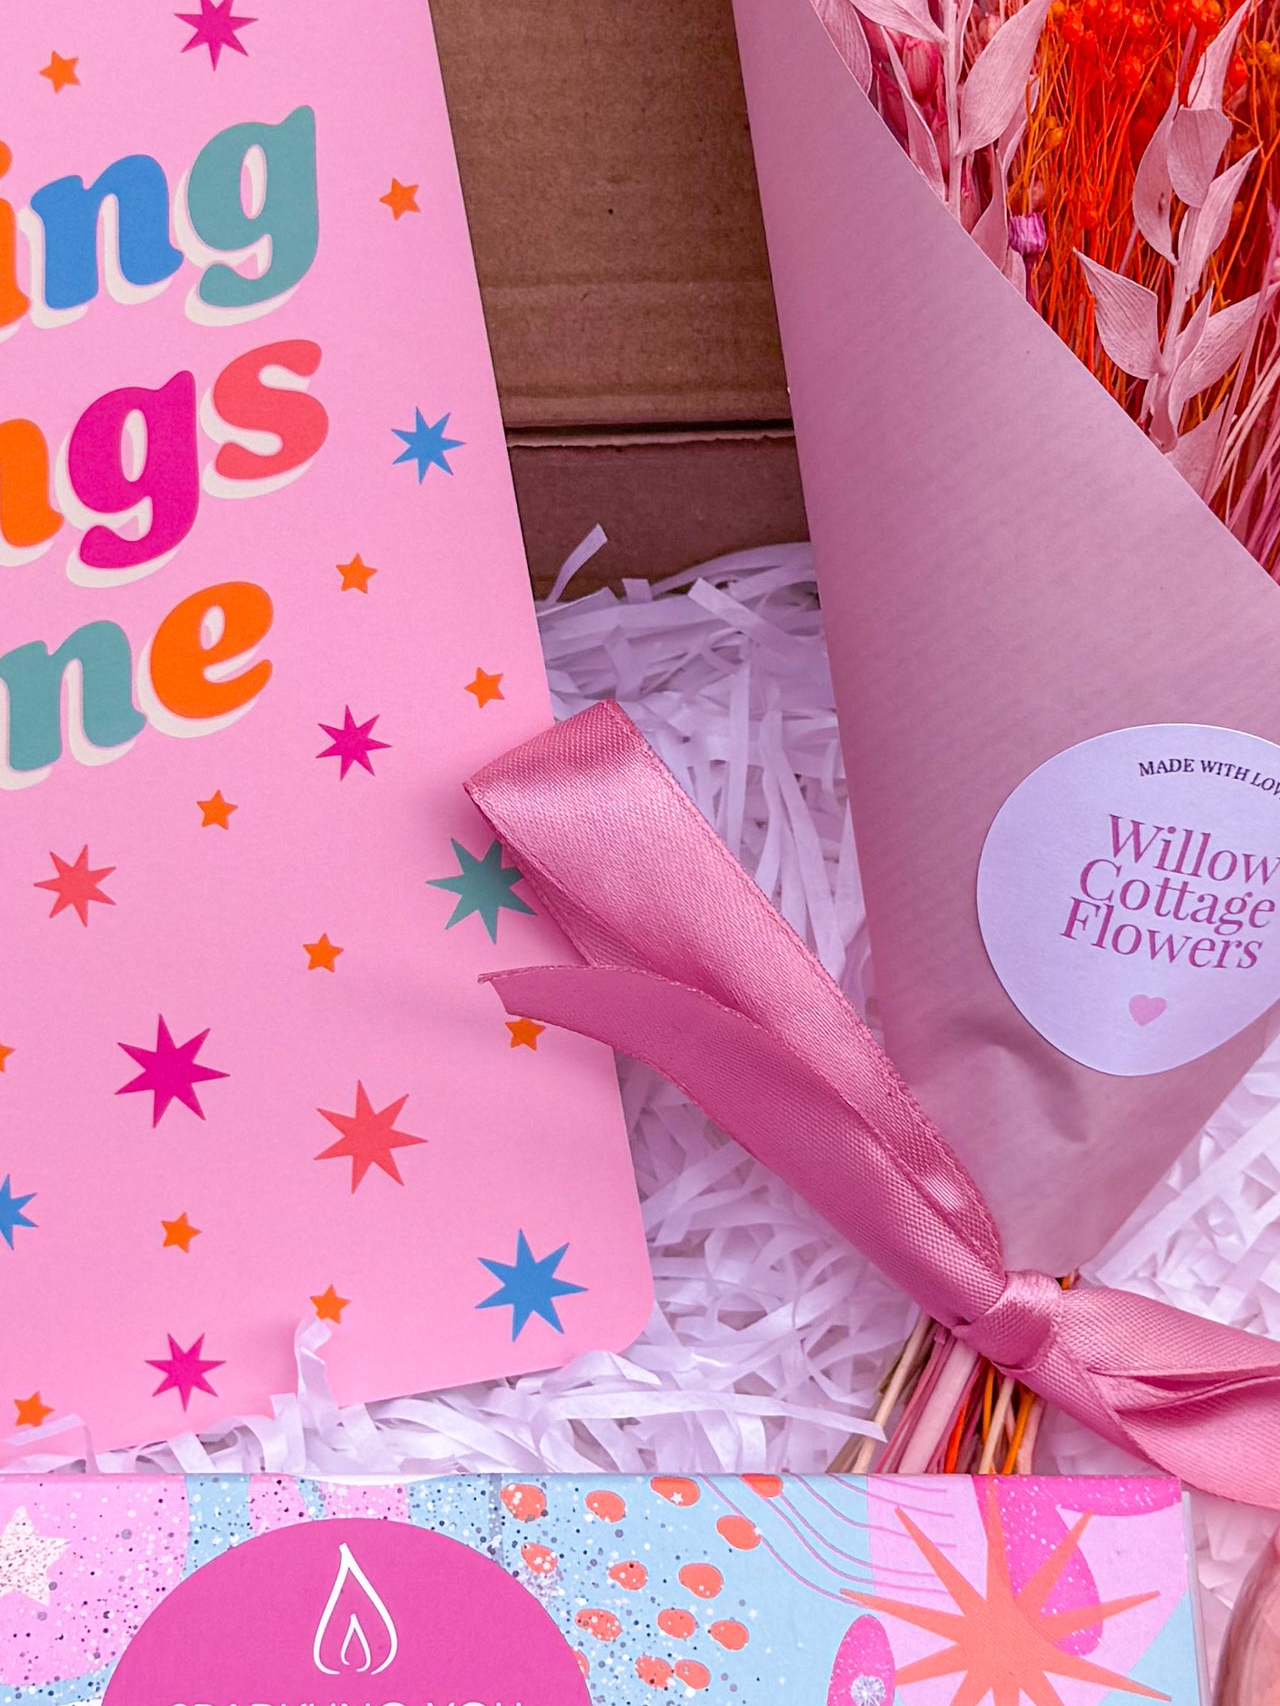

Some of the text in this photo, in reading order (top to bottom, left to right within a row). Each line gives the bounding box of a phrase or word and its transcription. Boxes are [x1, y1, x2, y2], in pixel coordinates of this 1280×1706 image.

[1137, 758, 1195, 778] MADE
[1200, 760, 1251, 782] WITH
[1059, 896, 1264, 970] Flowers
[1079, 858, 1276, 936] Cottage
